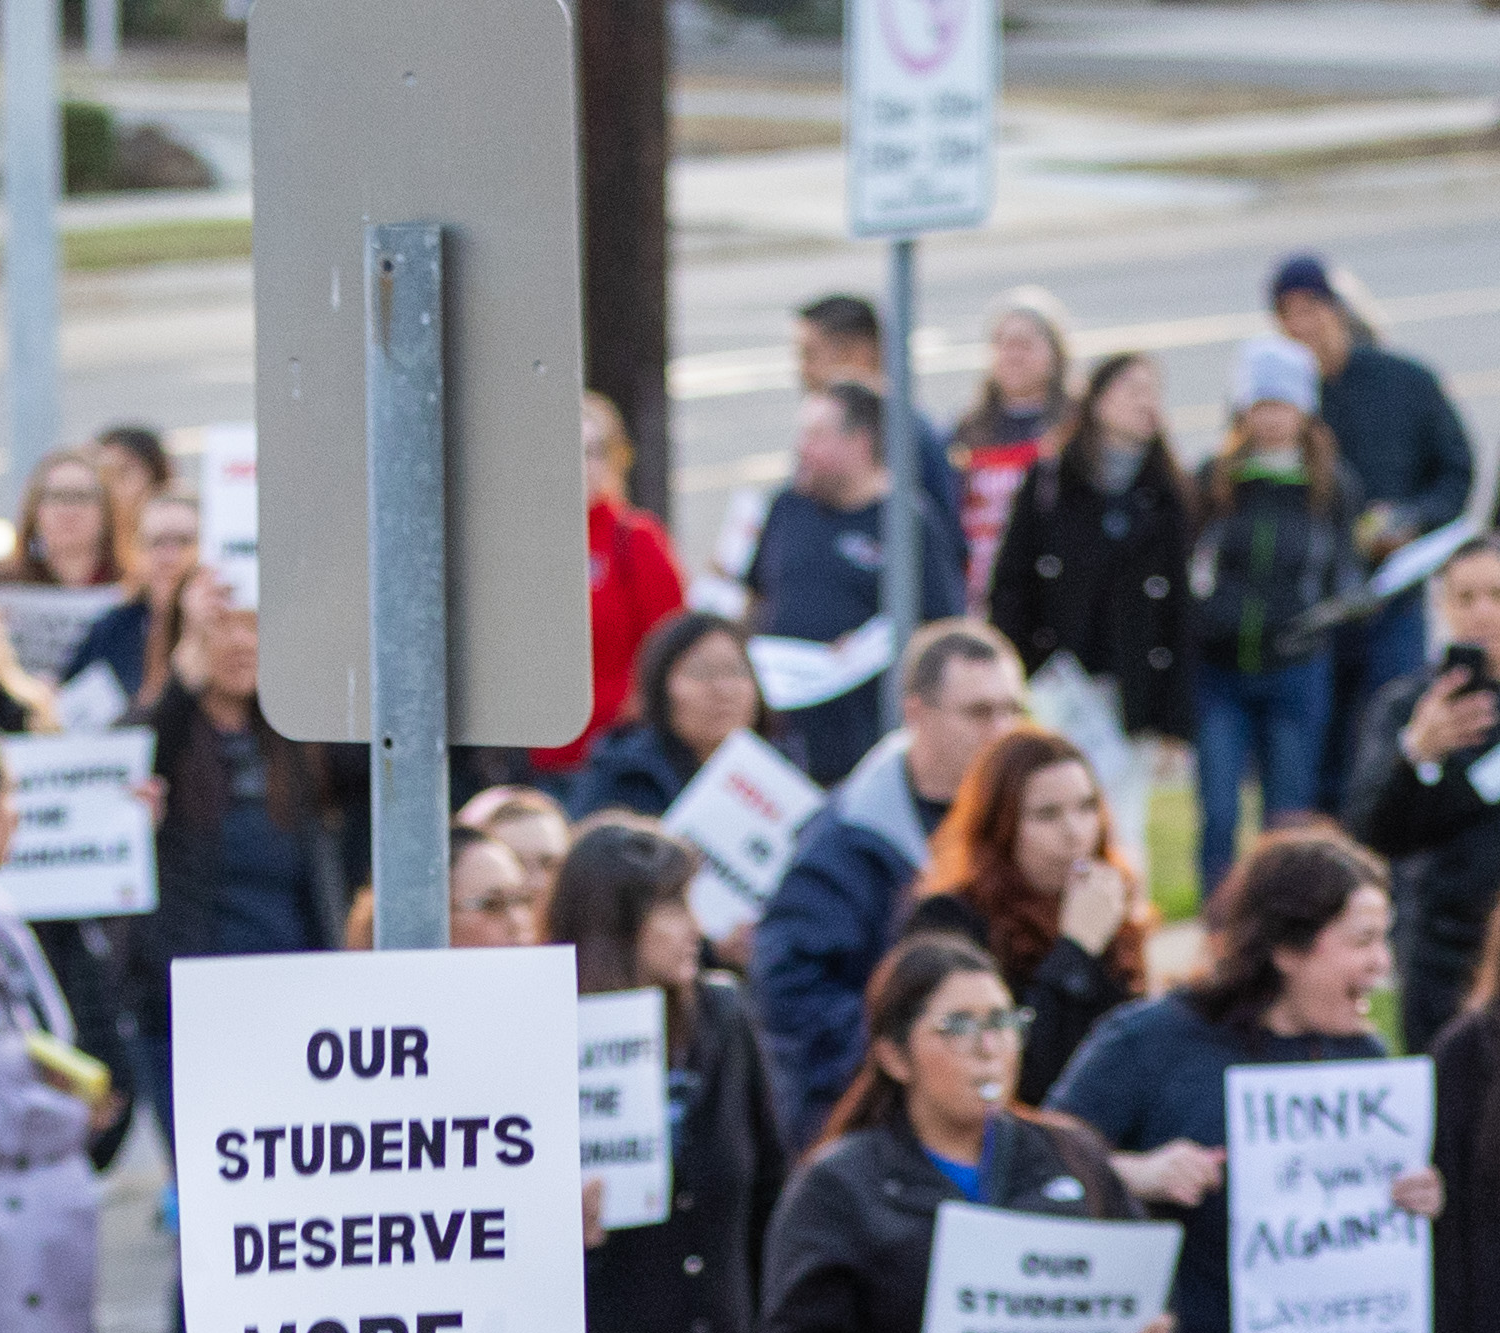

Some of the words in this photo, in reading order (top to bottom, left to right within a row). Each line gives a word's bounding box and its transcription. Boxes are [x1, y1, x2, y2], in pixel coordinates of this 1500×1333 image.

[306, 1026, 430, 1079] OUR
[1243, 1088, 1410, 1141] HONK
[215, 1115, 535, 1181] STUDENTS
[233, 1209, 507, 1275] DESERVE
[958, 1287, 1136, 1318] STUDENTS
